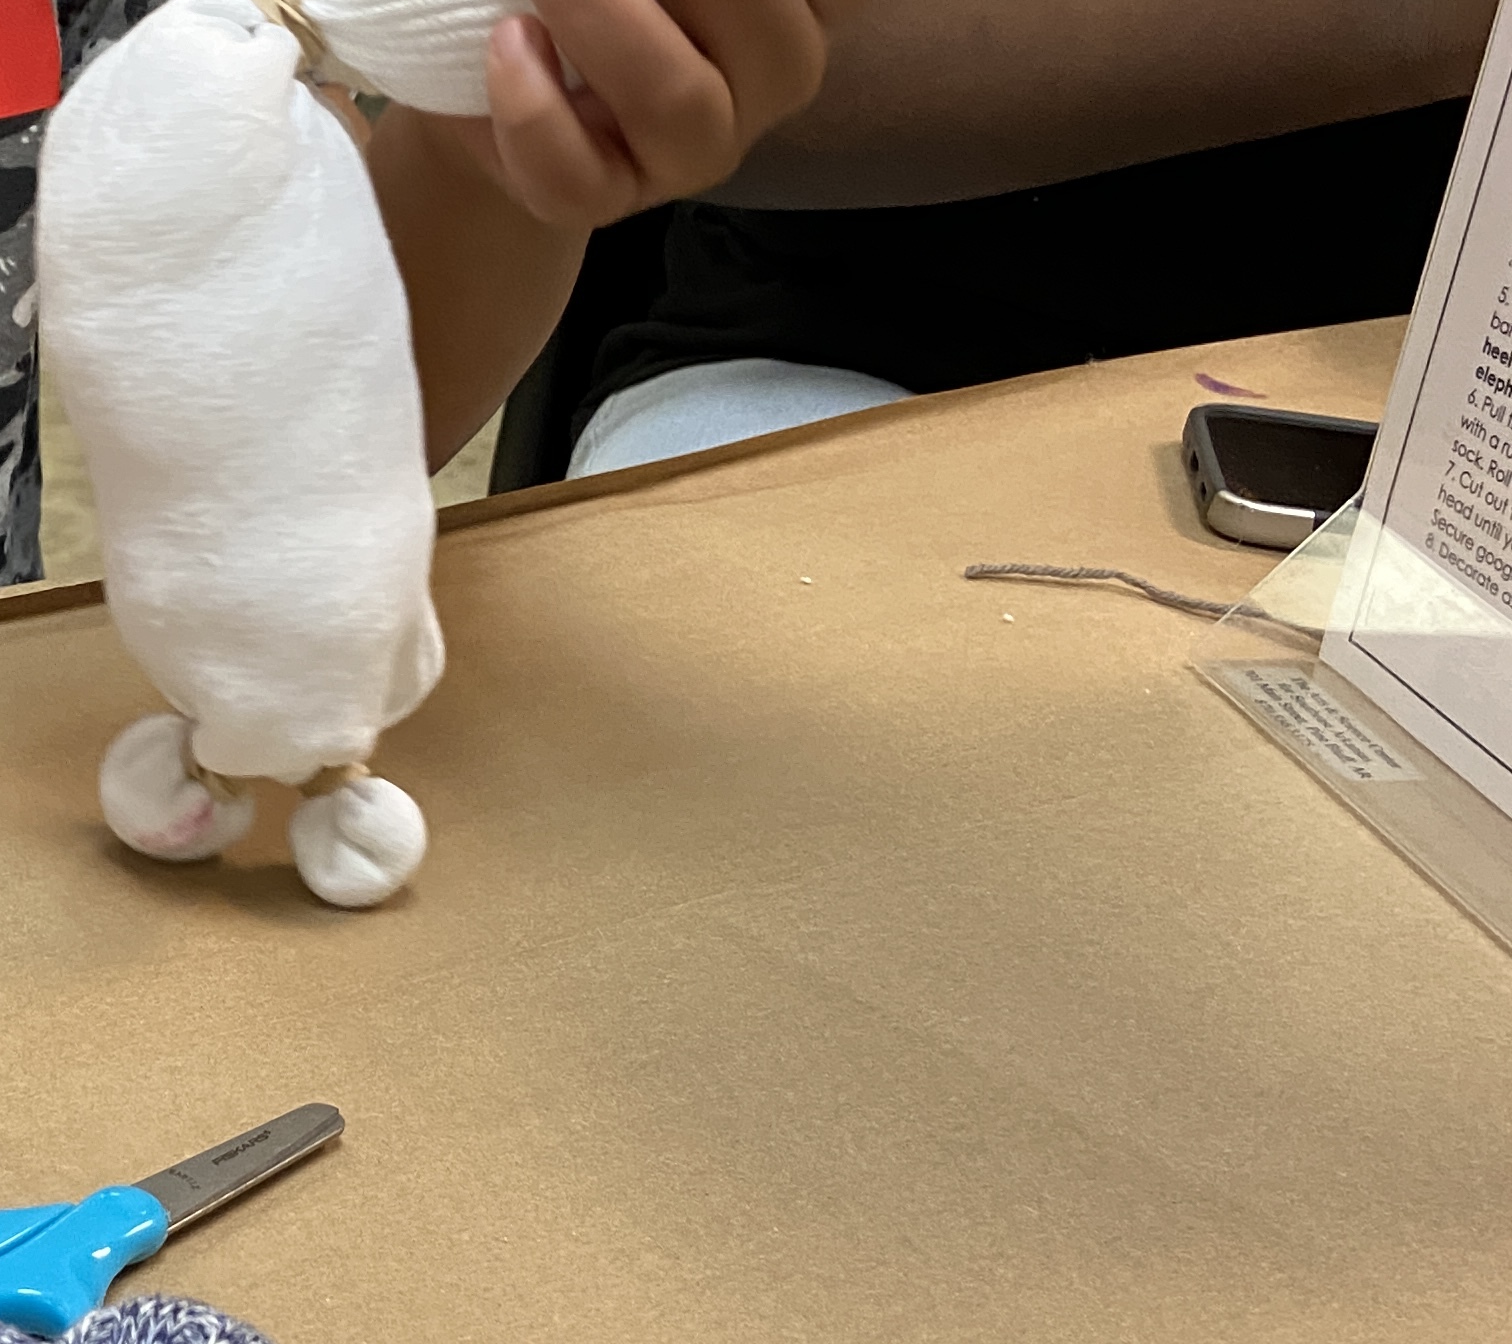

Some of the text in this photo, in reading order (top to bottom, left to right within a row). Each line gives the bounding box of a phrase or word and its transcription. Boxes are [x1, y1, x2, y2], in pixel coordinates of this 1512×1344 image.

[1467, 388, 1478, 407] 6.
[1481, 396, 1507, 423] Pull
[1461, 414, 1487, 442] with
[1489, 435, 1500, 450] a
[1445, 460, 1456, 481] 7.
[1459, 471, 1484, 497] Cut
[1485, 492, 1509, 515] out
[1431, 508, 1474, 551] Secure
[1438, 484, 1474, 520] head
[1475, 513, 1503, 541] until
[1439, 542, 1499, 596] Decorate
